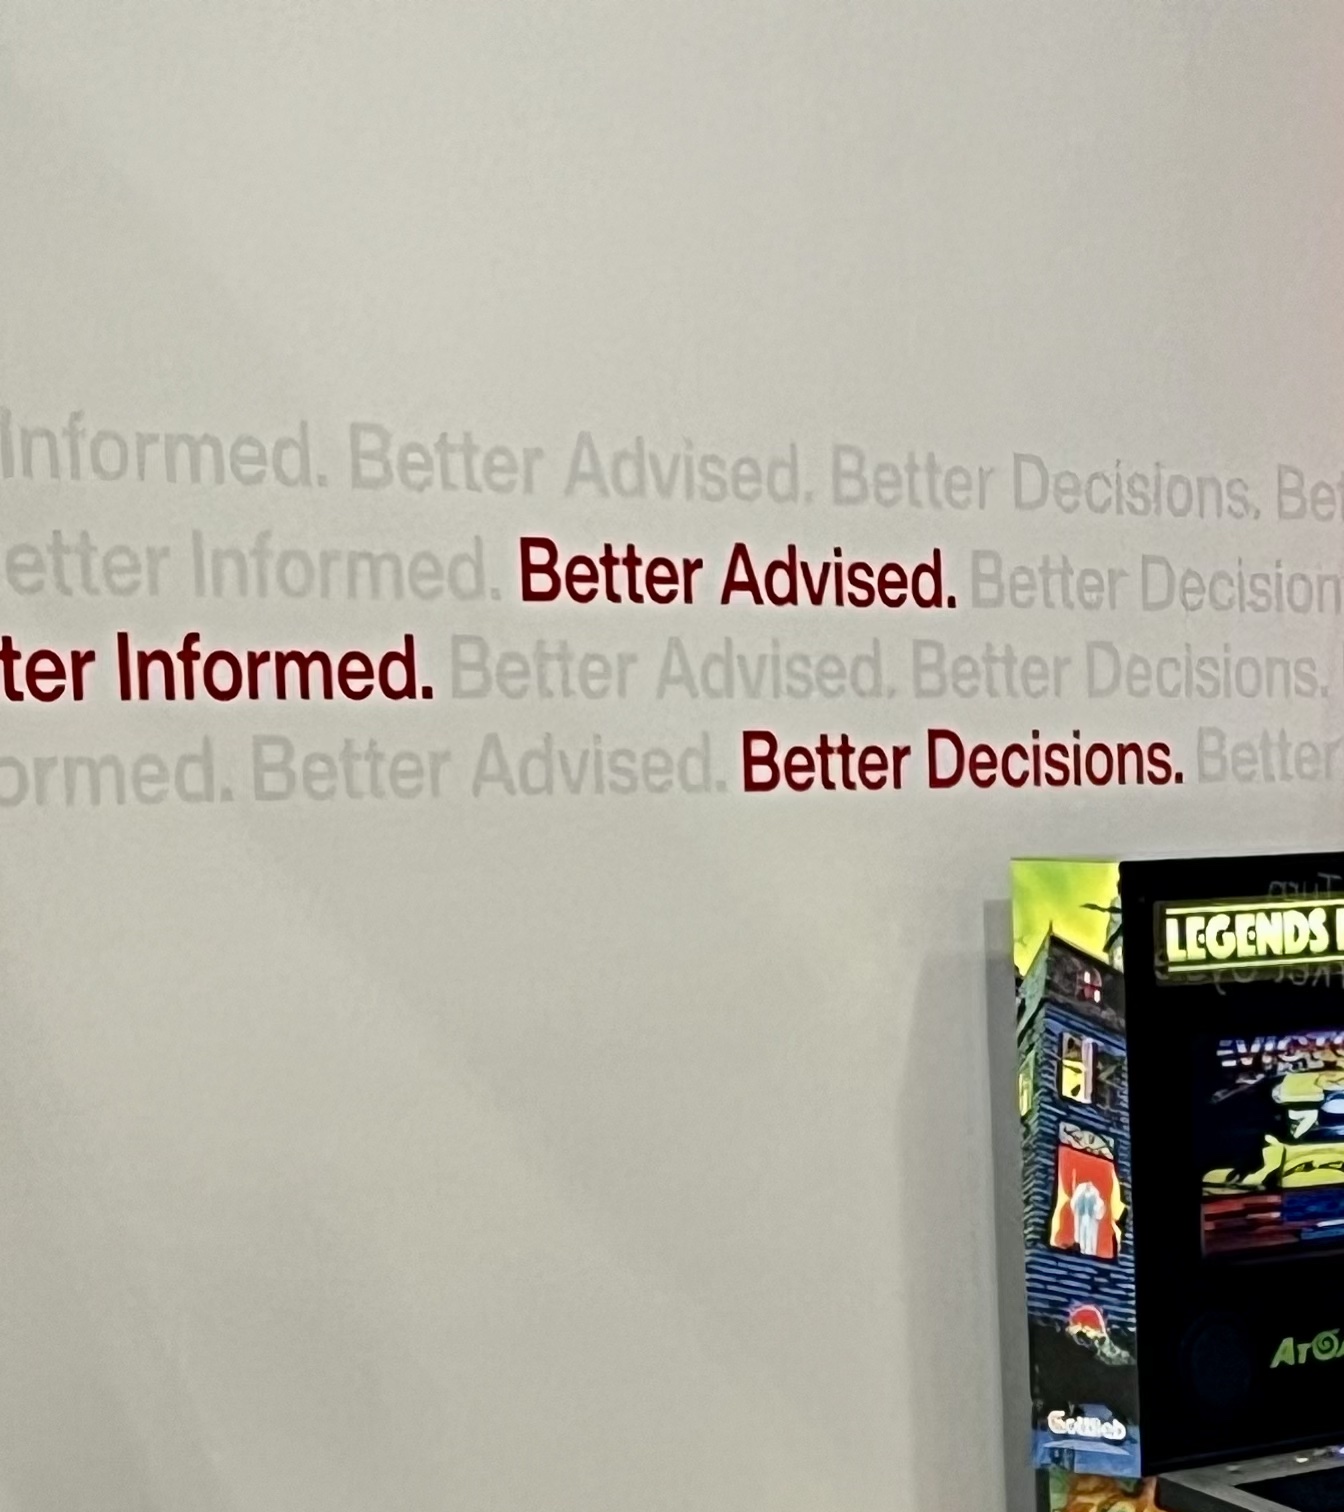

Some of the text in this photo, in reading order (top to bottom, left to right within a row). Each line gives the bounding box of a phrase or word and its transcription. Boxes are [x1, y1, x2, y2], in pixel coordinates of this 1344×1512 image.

[0, 409, 328, 487] Informed.
[350, 421, 543, 495] Better
[564, 431, 813, 504] Advised.
[832, 444, 994, 511] Better
[1012, 453, 1261, 521] Decisions.
[192, 529, 502, 600] Informed.
[519, 536, 703, 603] Better
[720, 542, 957, 608] Advised.
[970, 549, 1130, 610] Better
[117, 631, 433, 701] Informed.
[450, 634, 637, 699] Better
[656, 636, 896, 700] Advised.
[912, 637, 1071, 699] Better
[1086, 640, 1329, 699] Decisions.
[252, 734, 452, 800] Better
[471, 731, 728, 796] Advised.
[742, 730, 911, 792] Better
[926, 729, 1184, 788] Decisions.
[1199, 726, 1344, 783] Better
[1166, 908, 1330, 962] LEGENDS
